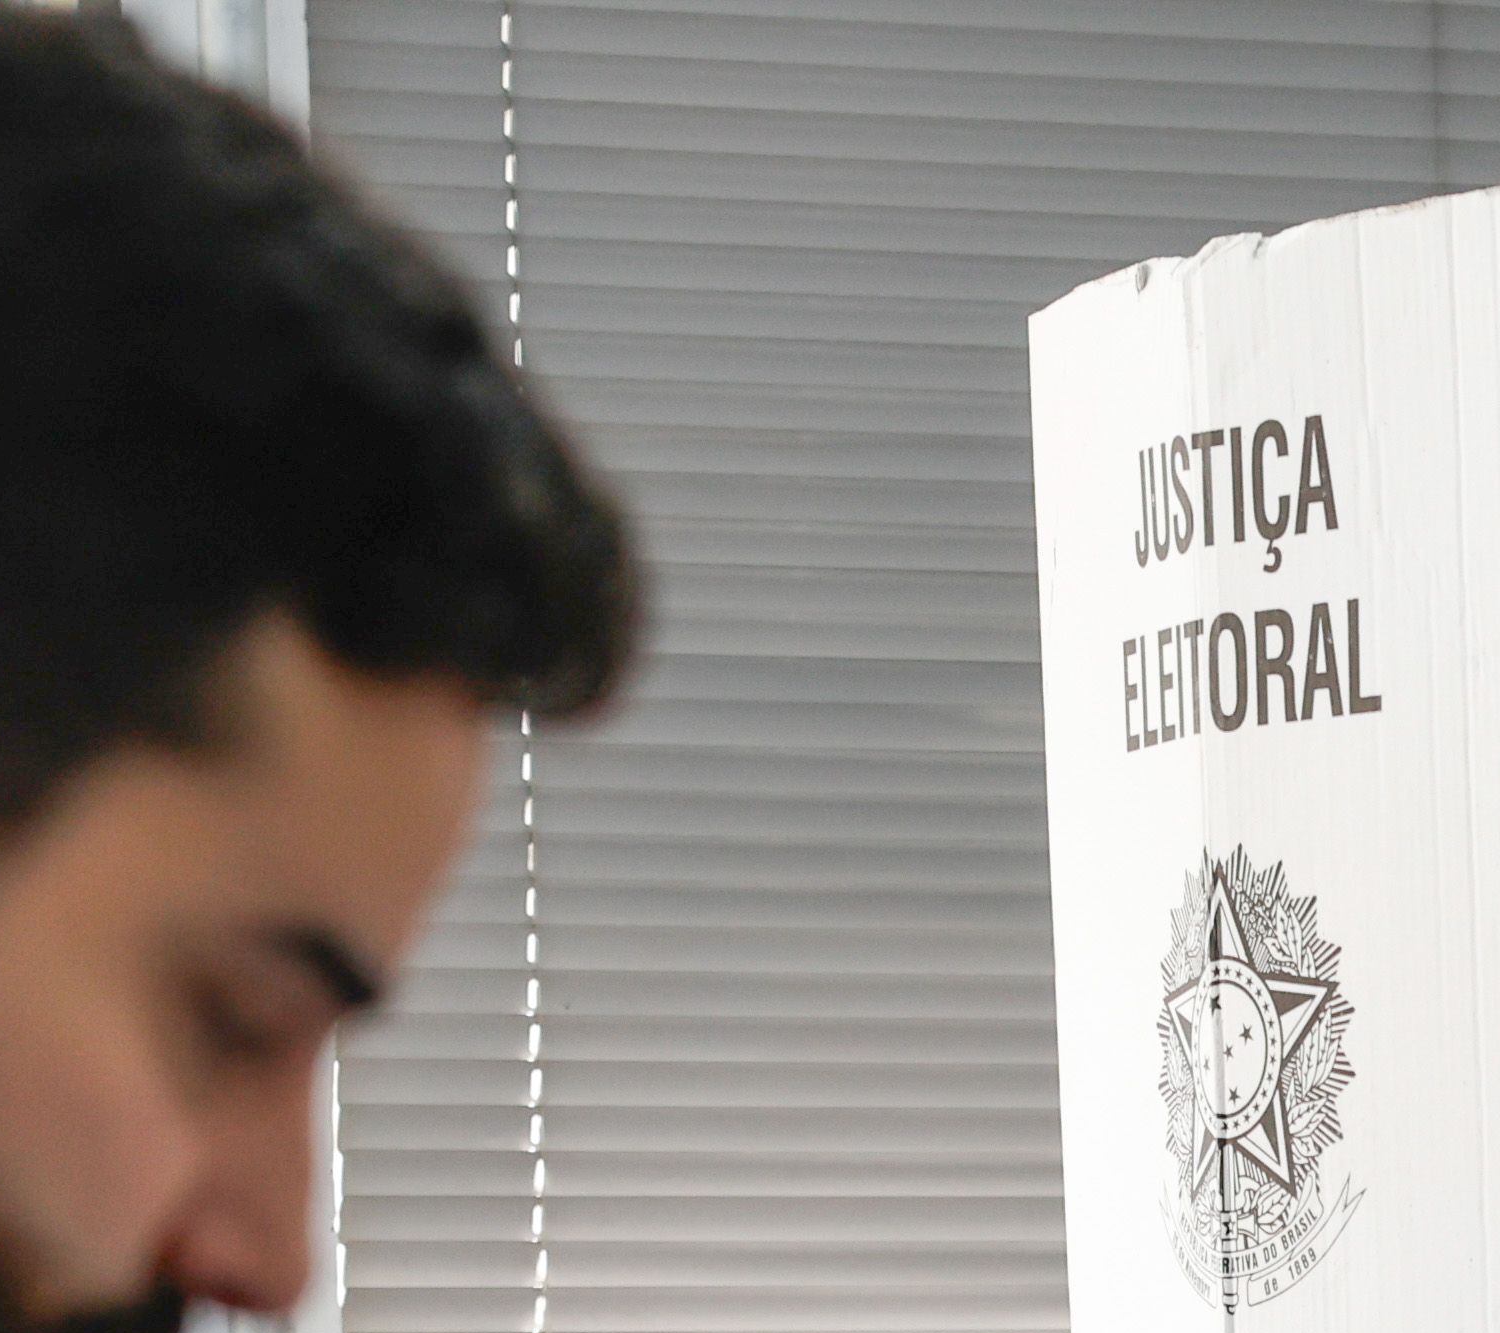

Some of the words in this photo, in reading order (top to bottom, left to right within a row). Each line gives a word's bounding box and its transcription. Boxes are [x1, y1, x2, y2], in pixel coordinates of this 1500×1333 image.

[1134, 413, 1339, 573] JUSTIÇA
[1122, 598, 1382, 753] ELEITORAL
[1210, 1252, 1259, 1275] RATIVA
[1263, 1243, 1278, 1264] DO
[1281, 1208, 1317, 1250] BRASIL
[1264, 1277, 1279, 1296] de
[1288, 1247, 1317, 1280] 1889
